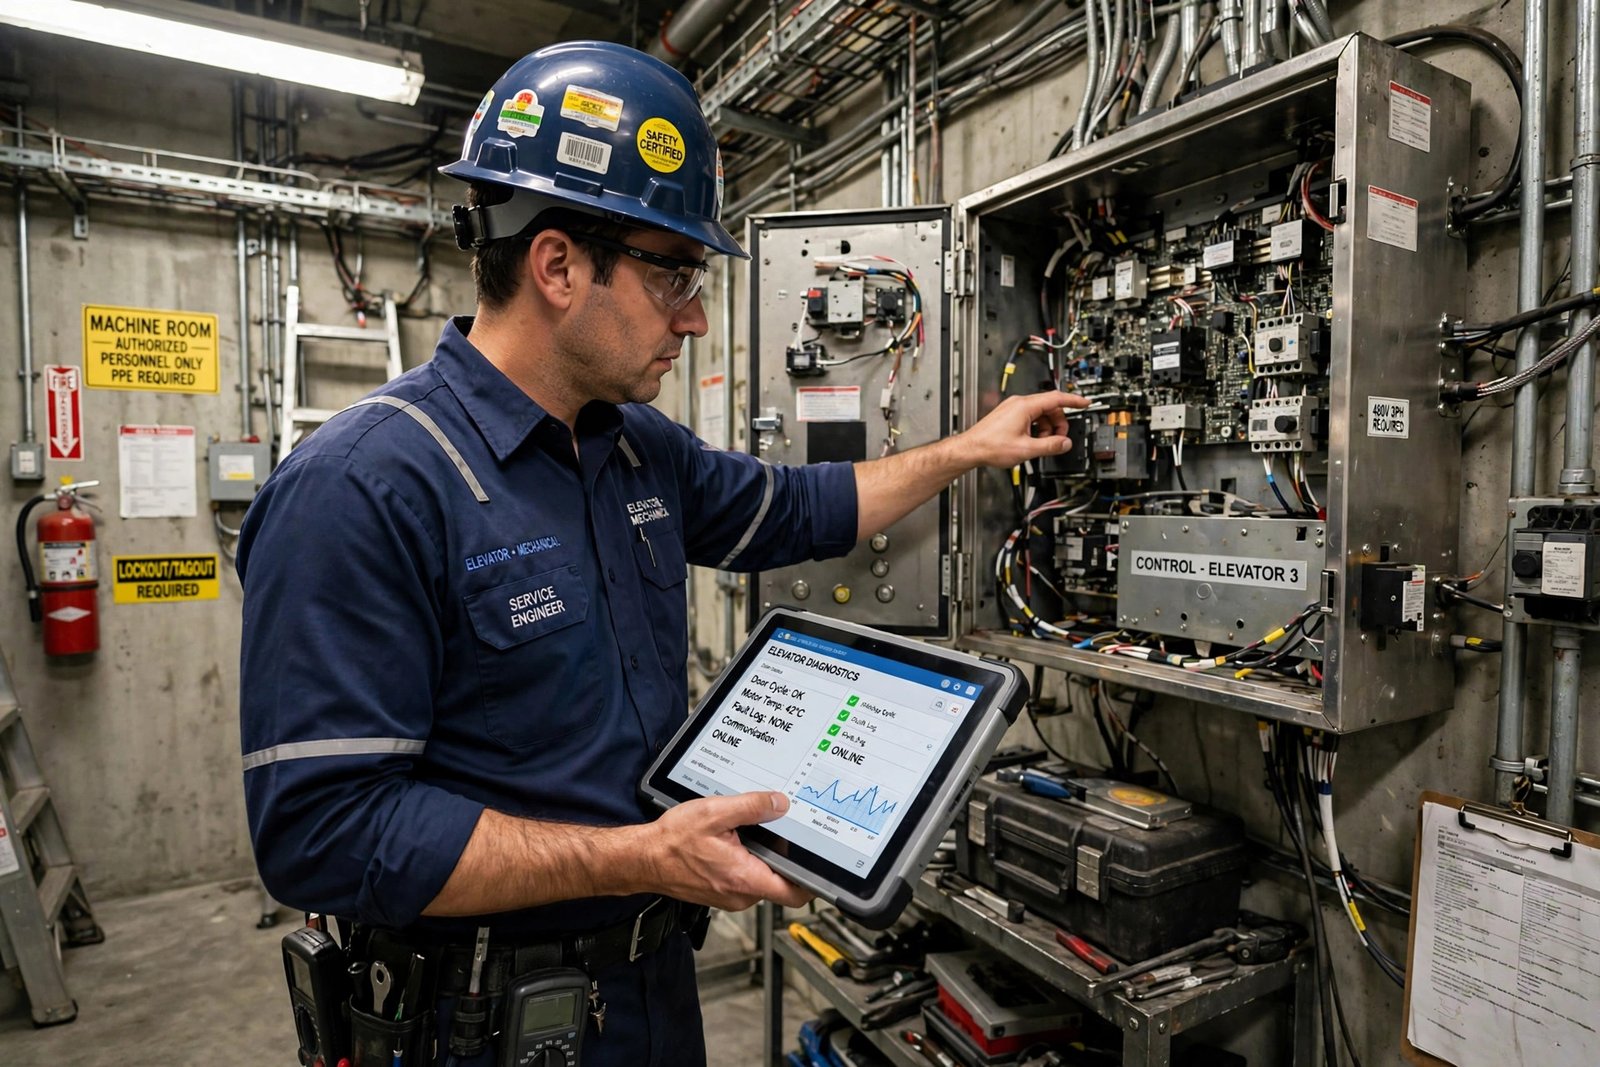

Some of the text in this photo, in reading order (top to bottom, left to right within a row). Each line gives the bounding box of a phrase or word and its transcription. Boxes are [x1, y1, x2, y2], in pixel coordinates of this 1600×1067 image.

[646, 129, 679, 147] SAFETY
[639, 139, 683, 161] CERTIFIED
[90, 314, 212, 338] MACHINE ROOM
[115, 337, 188, 353] AUTHORIZED
[100, 352, 203, 370] PERSONNEL ONLY
[111, 369, 196, 386] PPE REQUIRED
[465, 547, 512, 571] ELEVATOR
[516, 536, 561, 557] MECHANICAL
[118, 559, 214, 580] LOCKOUT/TAGOUT
[1136, 556, 1197, 574] CONTROL
[1208, 562, 1286, 582] ELEVATOR
[1290, 568, 1299, 583] 3
[137, 583, 199, 599] REQUIRED
[509, 585, 557, 611] SERVICE
[511, 599, 566, 628] ENGINEER
[767, 645, 807, 664] ELEVATOR
[805, 657, 860, 682] DIAGNOSTICS
[750, 674, 806, 700] Door Cycle: OK
[741, 687, 806, 718] Motor Temp: 42°C
[749, 707, 767, 723] Log:
[768, 715, 794, 733] NONE
[712, 728, 742, 748] ONLINE
[831, 745, 866, 766] ONLINE
